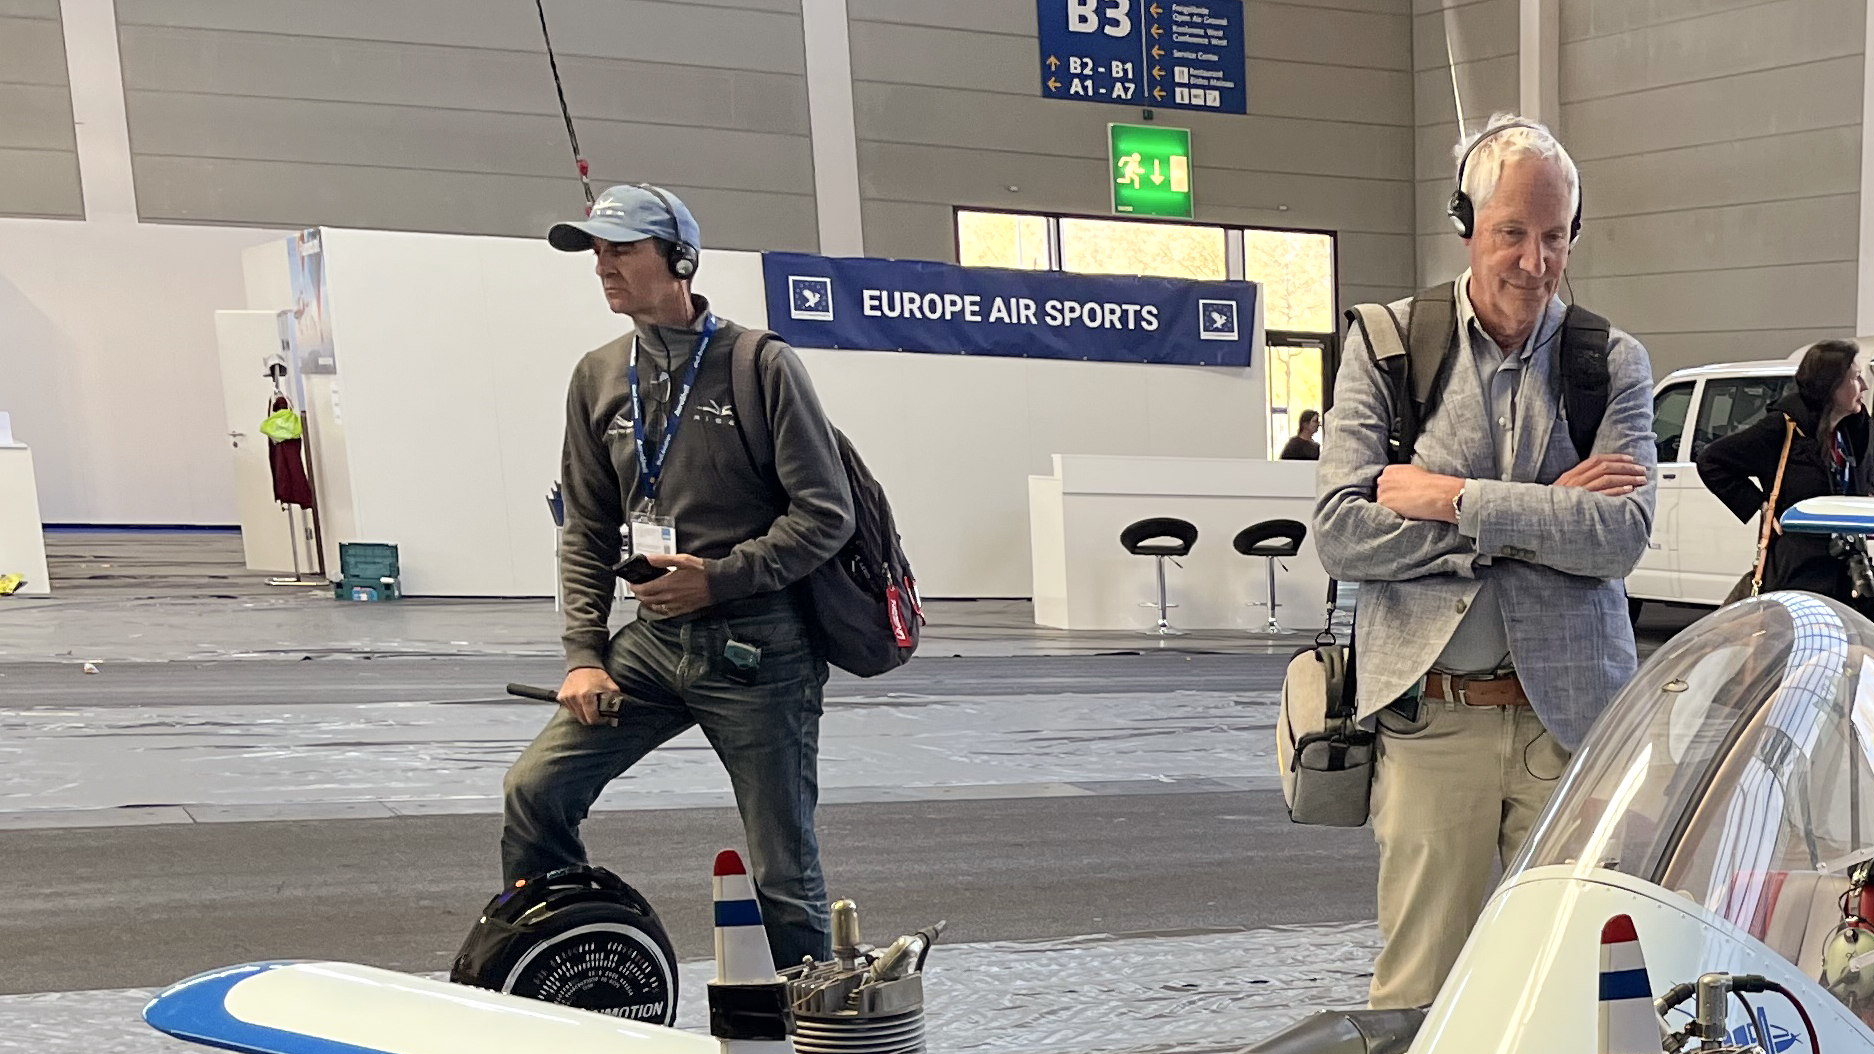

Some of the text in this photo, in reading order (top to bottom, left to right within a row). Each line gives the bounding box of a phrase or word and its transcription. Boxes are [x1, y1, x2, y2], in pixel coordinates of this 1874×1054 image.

[1067, 0, 1132, 38] B3
[1069, 56, 1094, 76] B2
[1111, 60, 1134, 79] B1
[1069, 78, 1094, 97] A1
[1111, 82, 1136, 100] A7
[862, 289, 1159, 331] EUROPE AIR SPORTS
